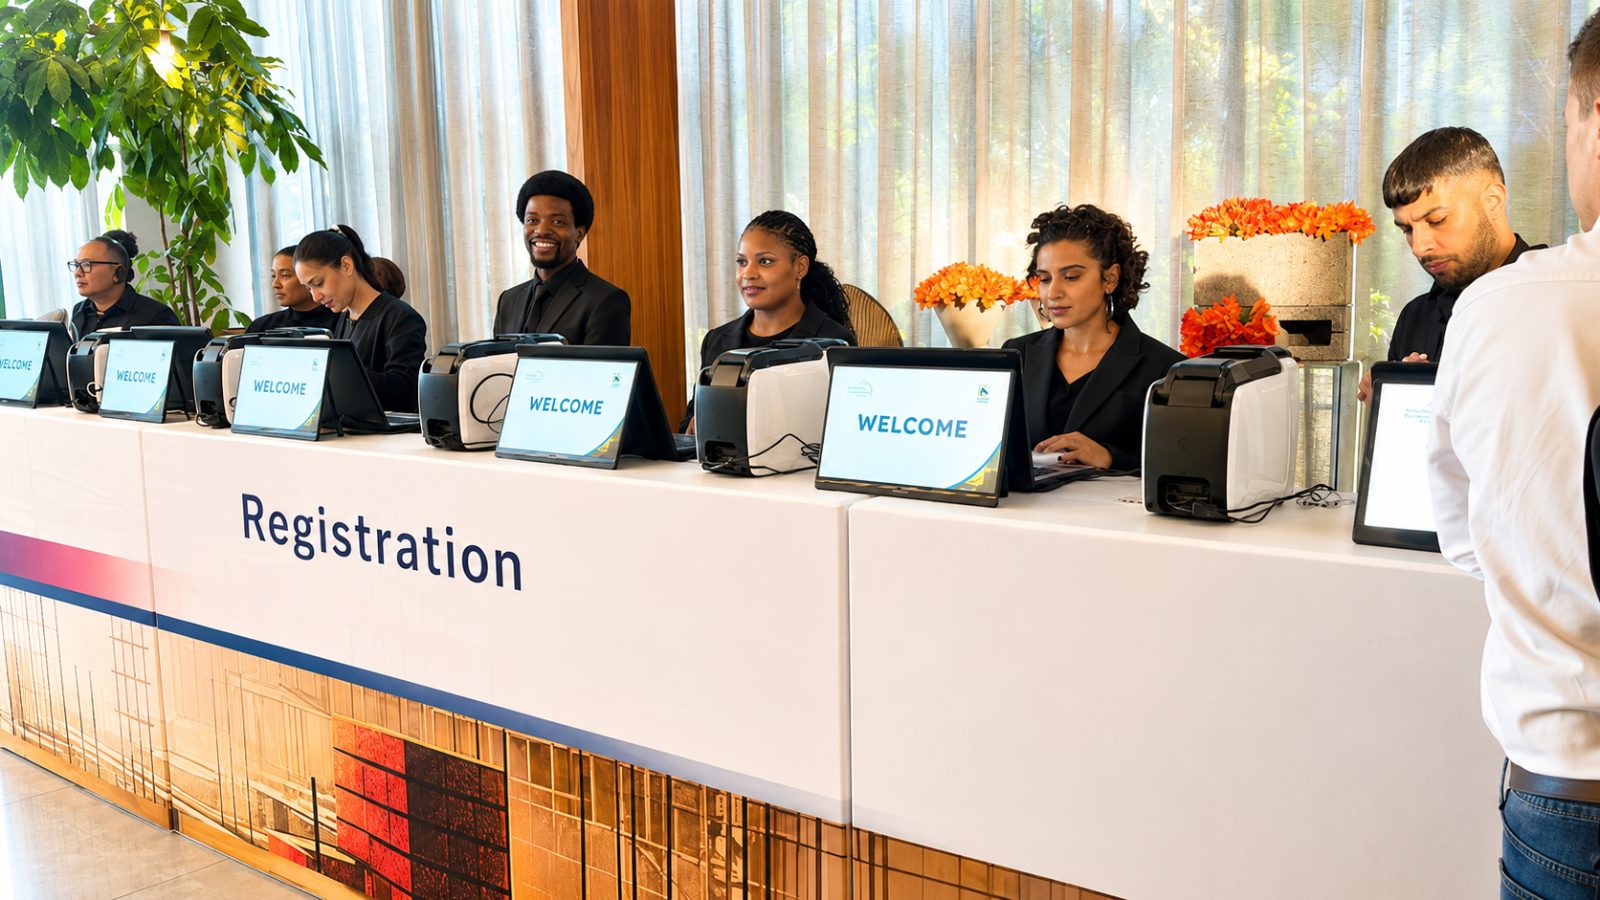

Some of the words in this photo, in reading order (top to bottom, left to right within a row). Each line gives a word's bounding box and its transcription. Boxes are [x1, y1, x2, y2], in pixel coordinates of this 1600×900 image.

[117, 370, 156, 384] WELCOME
[254, 380, 306, 395] WELCOME
[530, 396, 603, 415] WELCOME
[858, 413, 968, 438] WELCOME
[242, 493, 521, 591] Registration
